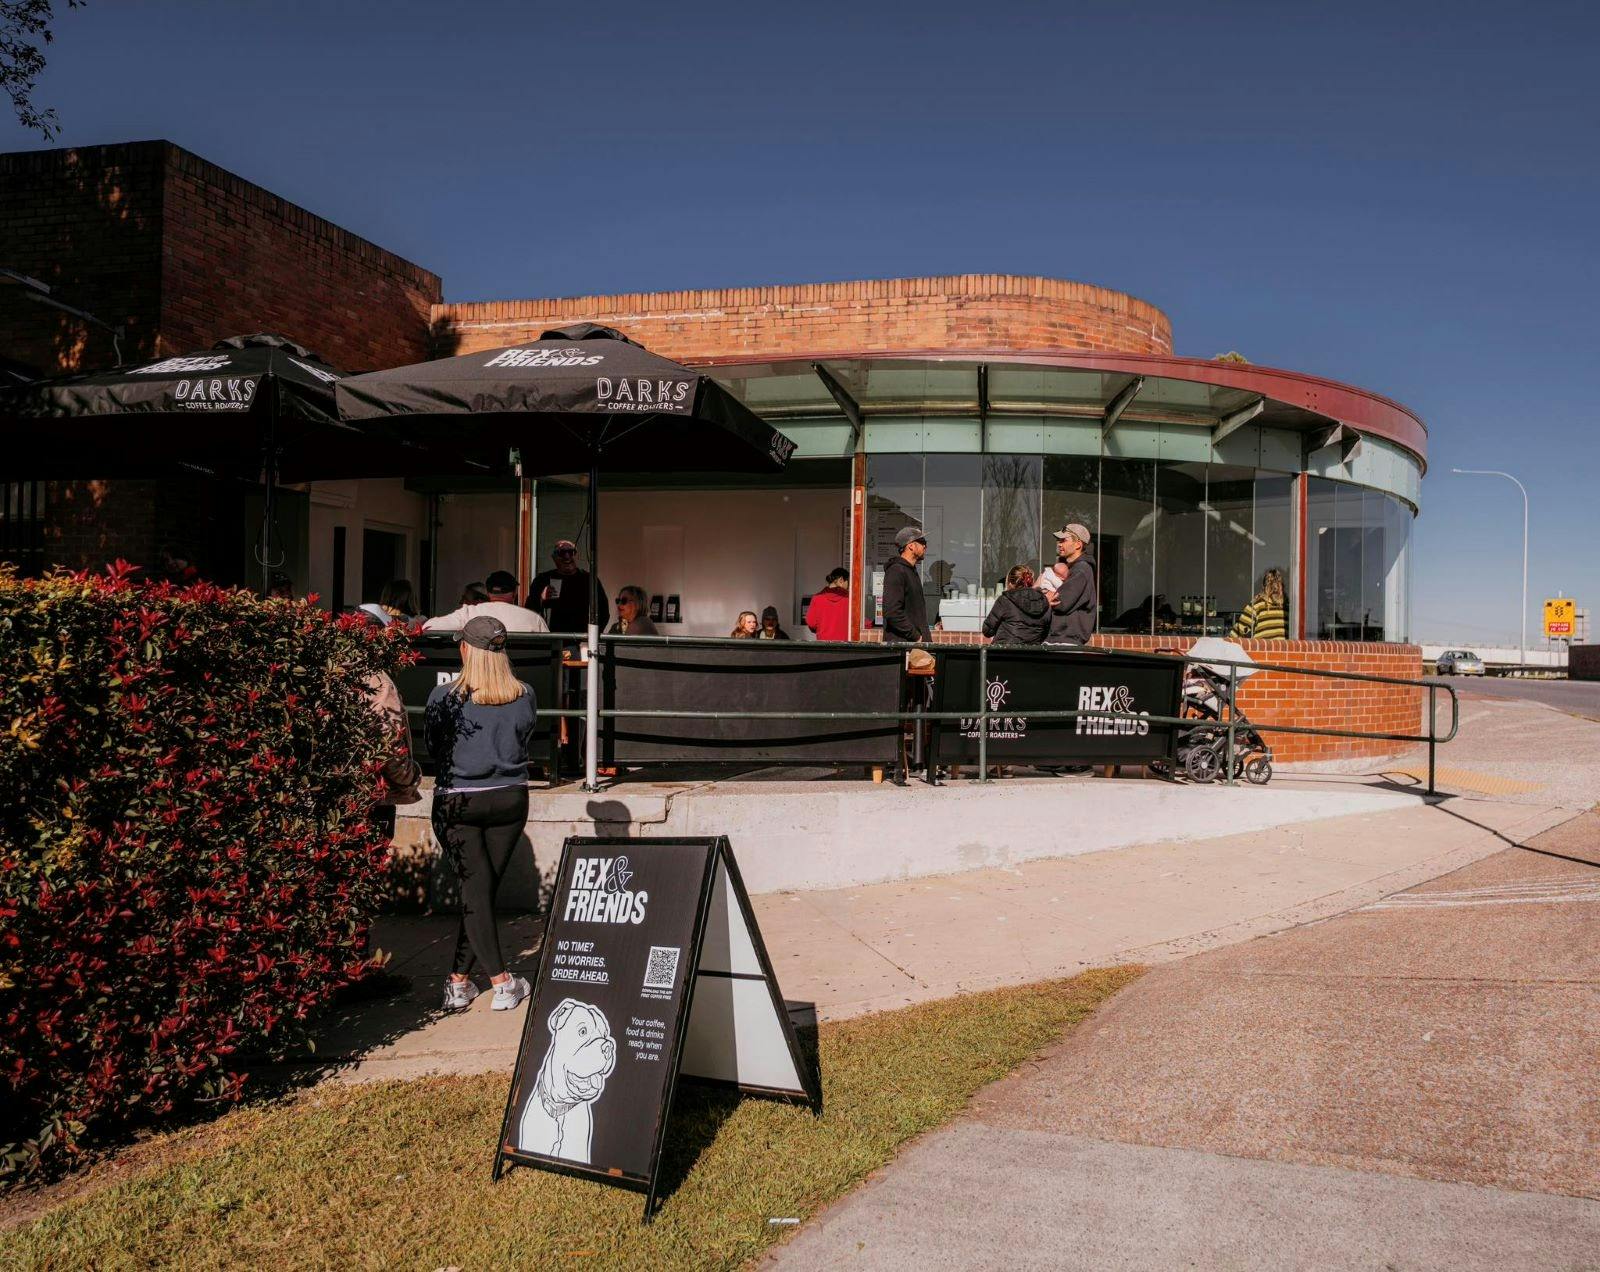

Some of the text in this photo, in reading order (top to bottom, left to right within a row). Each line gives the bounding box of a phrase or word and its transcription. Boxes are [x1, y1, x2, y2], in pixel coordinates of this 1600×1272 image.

[484, 355, 605, 367] FRIENDS
[175, 379, 256, 401] DARKS
[597, 377, 690, 402] DARKS
[185, 402, 213, 410] COFFEE
[607, 402, 636, 411] COFFEE
[1078, 685, 1135, 713] REX&
[1076, 711, 1150, 736] FRIENDS
[989, 731, 1019, 739] ROASTERS
[571, 856, 634, 894] REX&
[564, 888, 649, 925] FRIENDS
[557, 941, 595, 952] NO TIME?
[554, 954, 606, 967] NO WORRIES.
[551, 968, 610, 982] ORDER AHEAD.
[631, 1016, 666, 1029] Your coffee,
[625, 1027, 664, 1039] food & drinks
[628, 1040, 663, 1050] ready when
[636, 1051, 660, 1061] you are.
